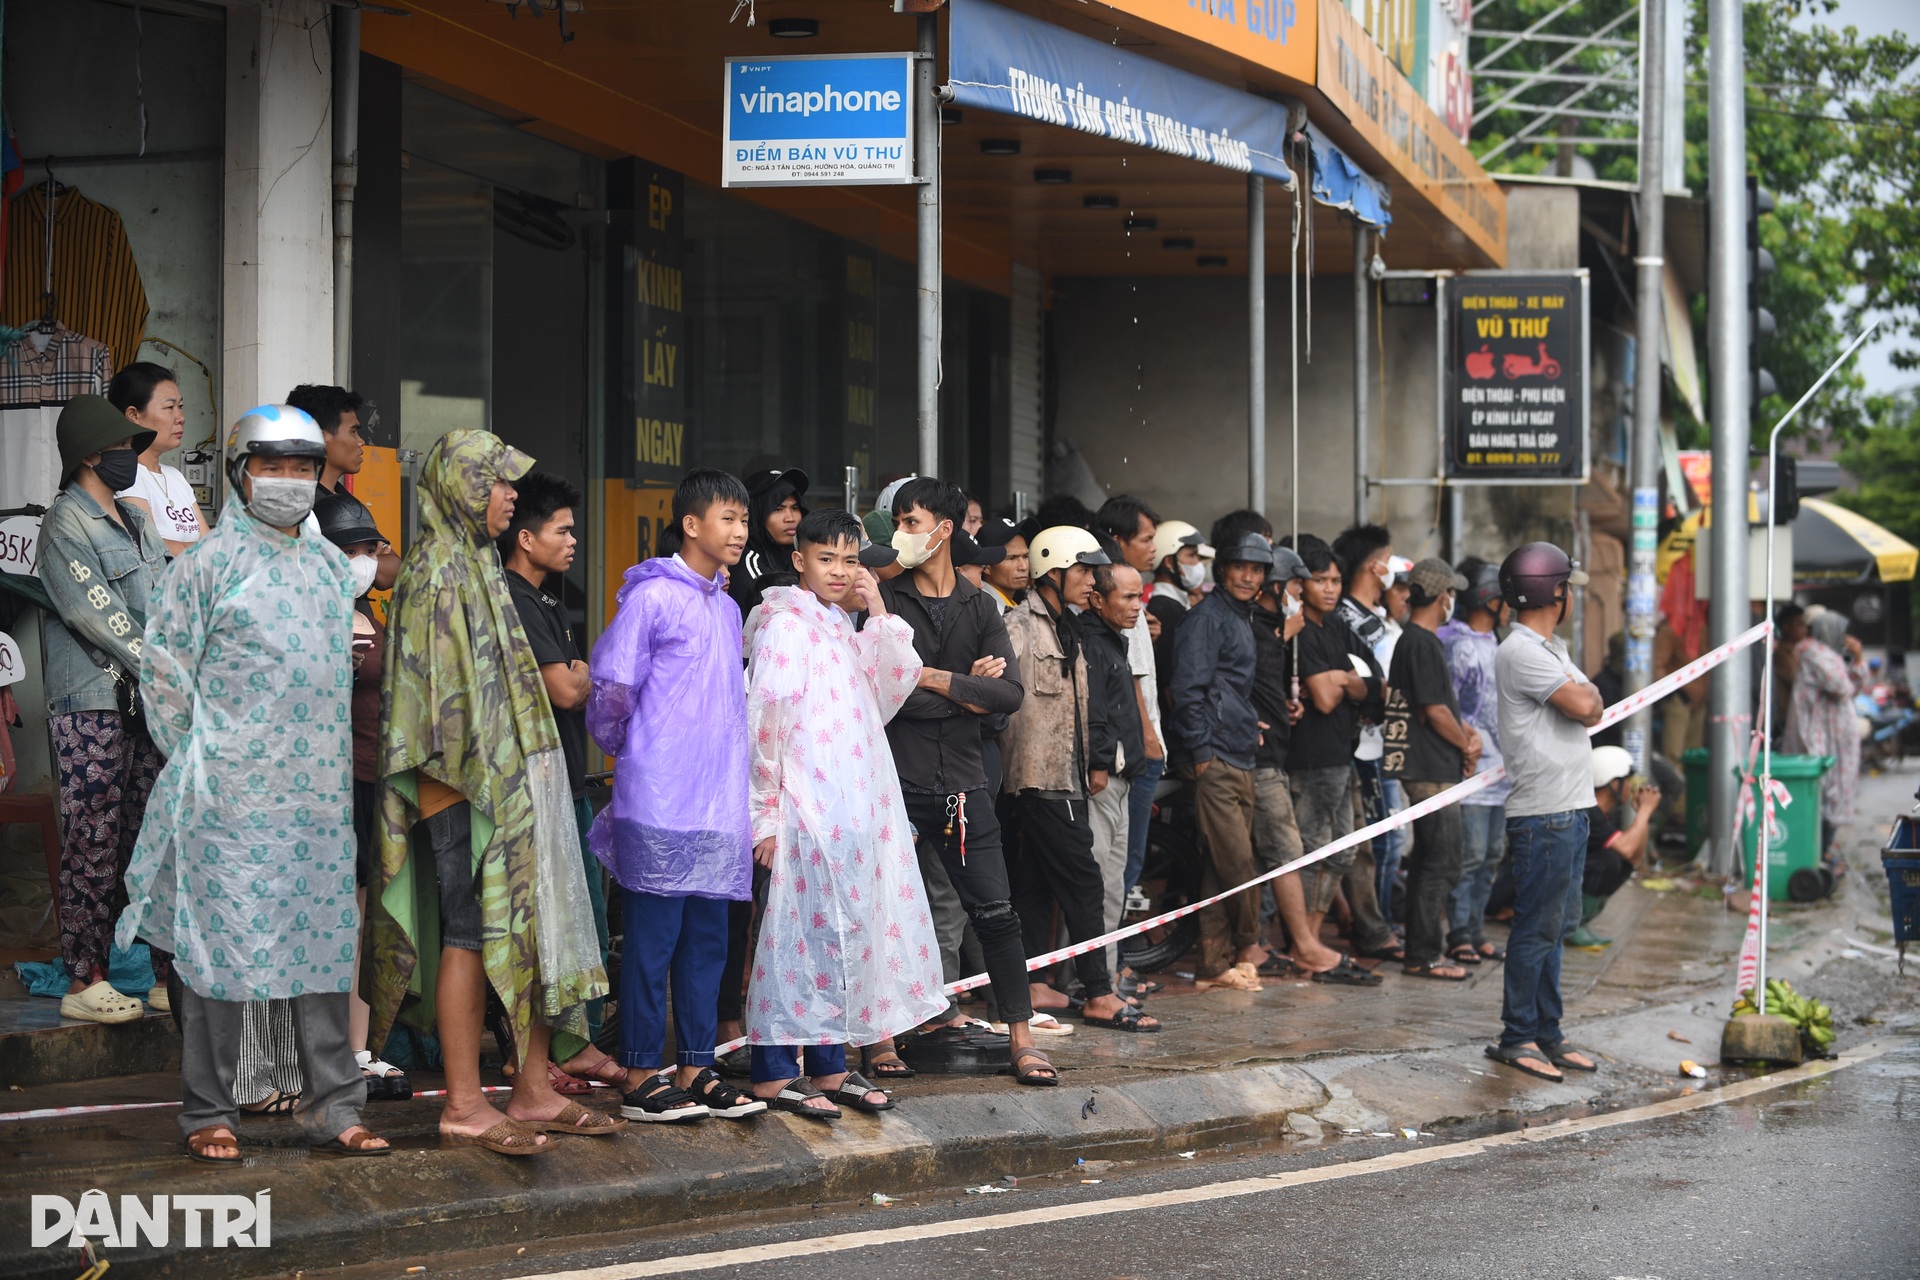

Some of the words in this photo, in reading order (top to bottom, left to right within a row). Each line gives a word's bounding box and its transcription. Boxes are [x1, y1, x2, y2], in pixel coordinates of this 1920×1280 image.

[740, 84, 901, 117] vinaphone
[1008, 66, 1067, 126] TRUNG
[1066, 82, 1106, 136] TÂM
[736, 141, 782, 162] ĐIỂM
[788, 144, 827, 161] BÁN
[834, 144, 858, 160] VŨ
[864, 145, 903, 160] THƯ
[648, 173, 673, 232] ÉP
[637, 249, 683, 313] KÍNH
[1526, 295, 1539, 310] XE
[1476, 313, 1504, 339] VŨ
[1508, 316, 1550, 339] THƯ
[643, 325, 677, 388] LẤY
[1471, 408, 1485, 426] ÉP
[1530, 410, 1555, 426] NGAY
[636, 416, 684, 467] NGAY
